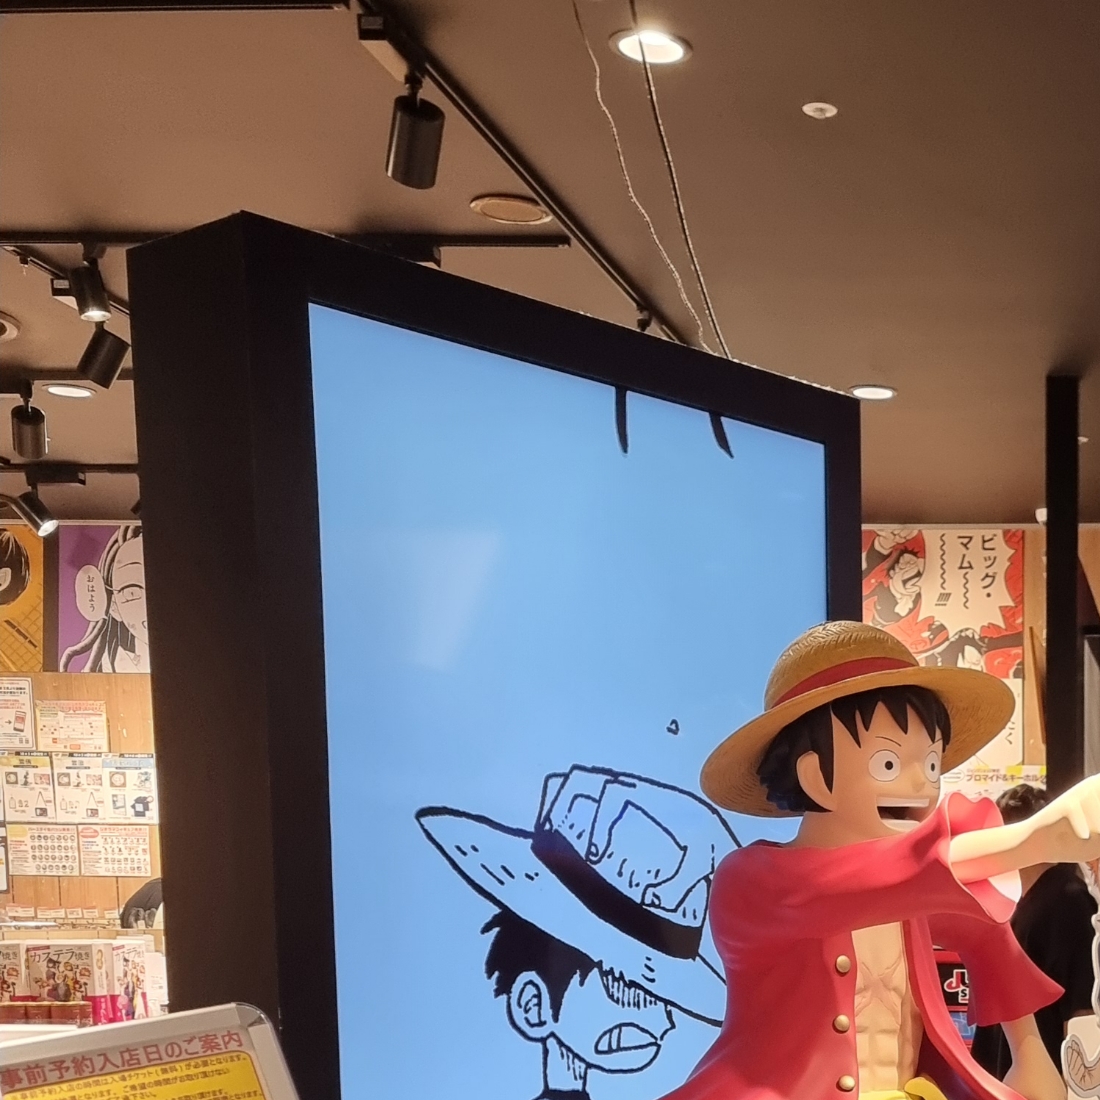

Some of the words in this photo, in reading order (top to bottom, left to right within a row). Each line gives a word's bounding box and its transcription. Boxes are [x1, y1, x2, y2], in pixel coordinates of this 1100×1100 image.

[86, 574, 96, 612] おはよう
[0, 1030, 243, 1088] 事前予約入店日のご案内
